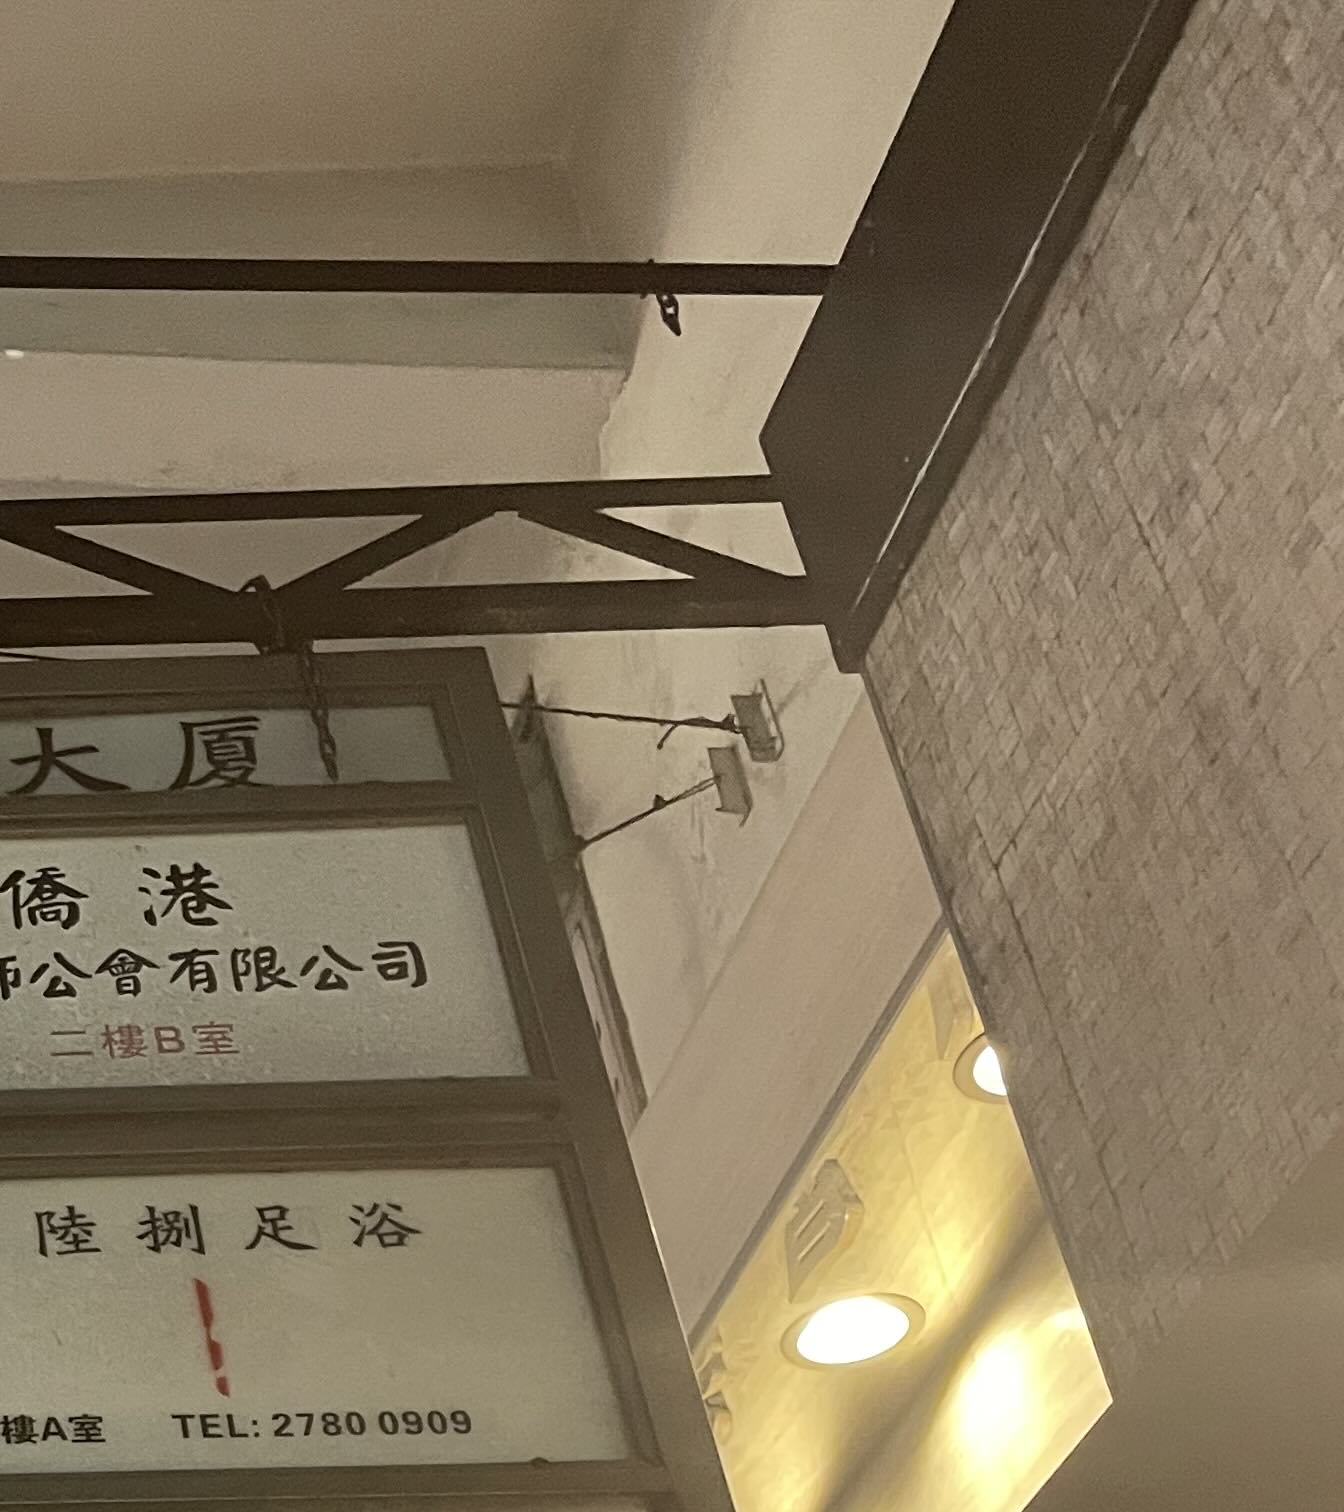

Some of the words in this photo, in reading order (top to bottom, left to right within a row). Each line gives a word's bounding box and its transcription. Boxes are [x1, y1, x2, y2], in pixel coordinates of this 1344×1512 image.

[50, 1021, 240, 1059] 二樓B室
[172, 1412, 261, 1440] TEL:
[272, 1411, 366, 1438] 2780
[378, 1409, 473, 1436] 0909
